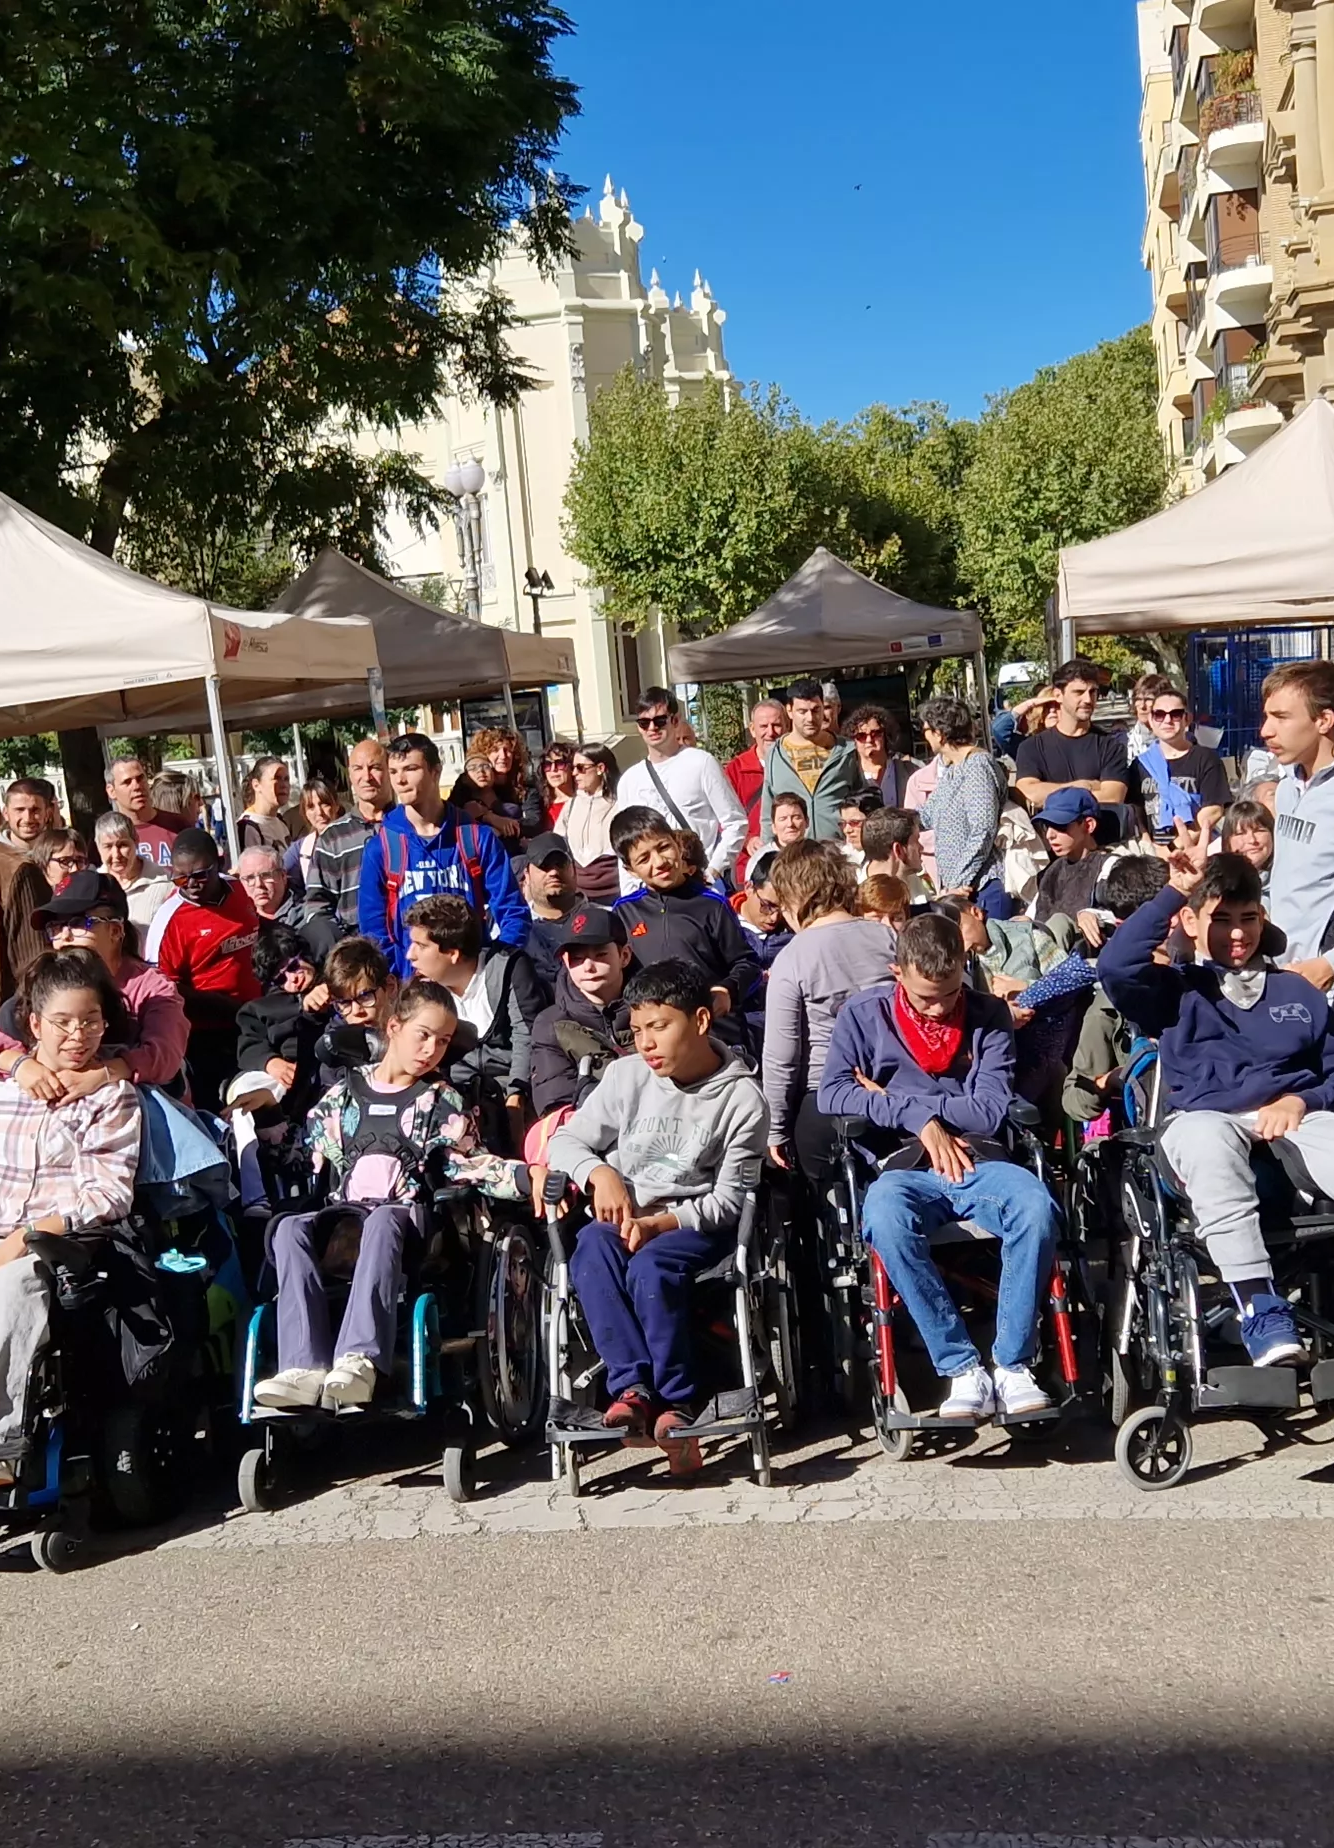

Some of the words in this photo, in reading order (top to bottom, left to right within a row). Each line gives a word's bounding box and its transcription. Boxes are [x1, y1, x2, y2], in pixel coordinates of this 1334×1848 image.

[136, 841, 173, 867] SA
[399, 870, 425, 899] EW
[623, 1117, 683, 1136] MOUNT
[692, 1122, 710, 1147] FU
